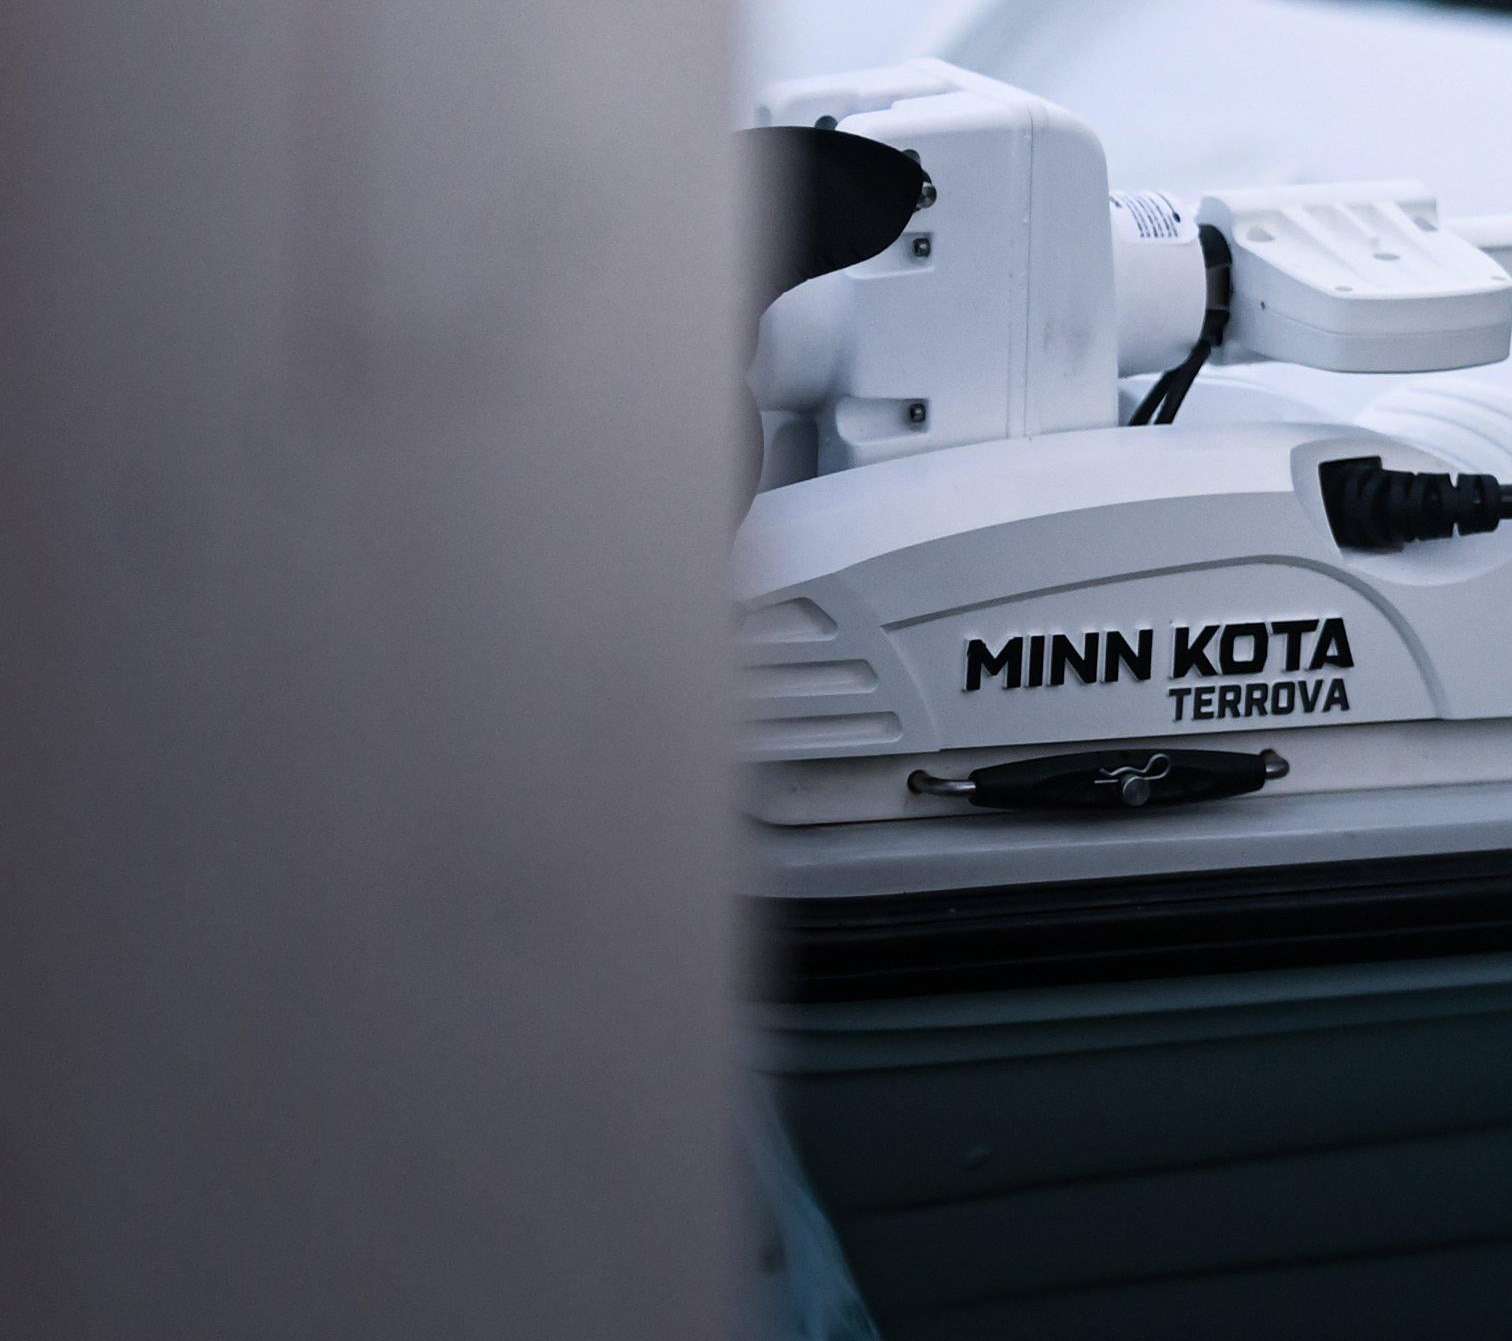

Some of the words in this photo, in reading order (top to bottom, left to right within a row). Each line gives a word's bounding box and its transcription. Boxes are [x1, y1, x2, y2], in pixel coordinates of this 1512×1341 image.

[962, 628, 1154, 692] MINN
[1171, 617, 1355, 679] KOTA
[1168, 678, 1351, 721] TERROVA
